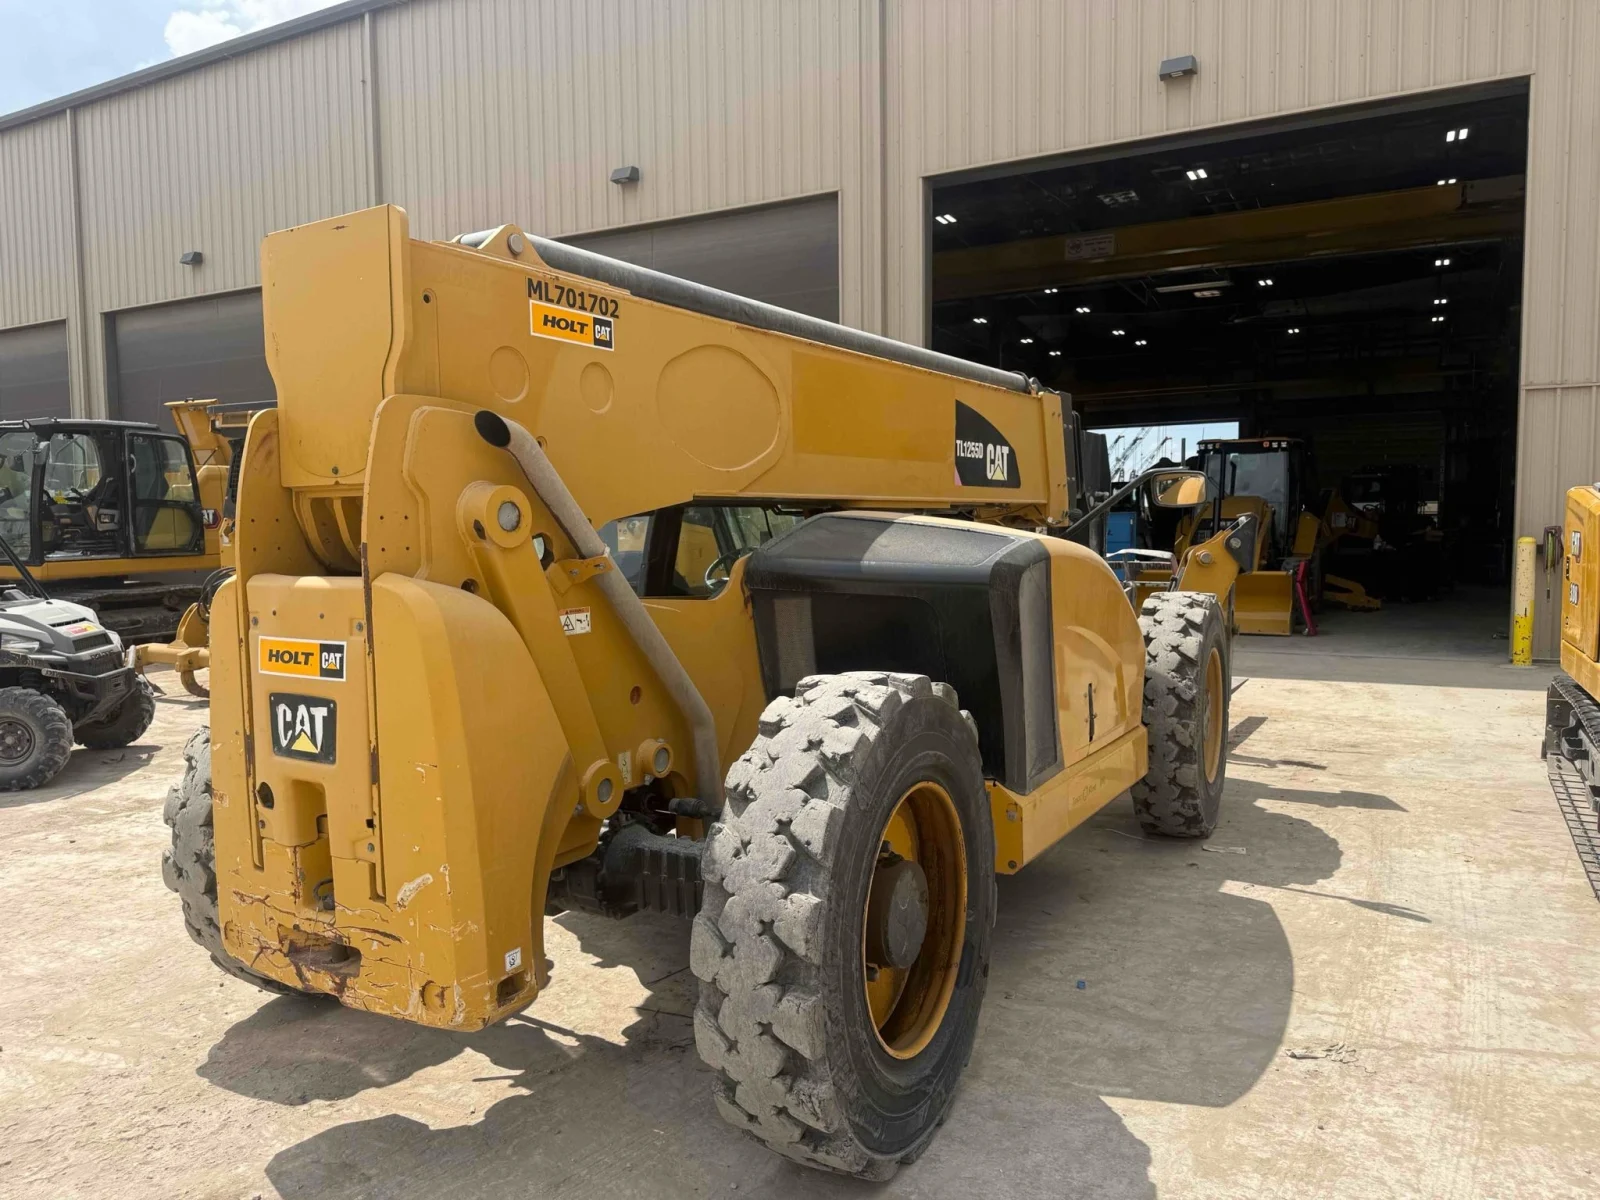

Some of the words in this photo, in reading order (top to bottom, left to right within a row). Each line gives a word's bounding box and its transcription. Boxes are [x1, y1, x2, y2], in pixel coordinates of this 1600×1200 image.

[527, 278, 620, 319] ML701702
[543, 314, 589, 335] HOLT
[595, 324, 611, 341] CAT
[956, 440, 984, 459] TL1255D
[986, 443, 1009, 481] CAT
[201, 509, 215, 525] AT
[268, 648, 315, 666] HOLT
[321, 651, 343, 670] CAT
[276, 703, 328, 754] CAT
